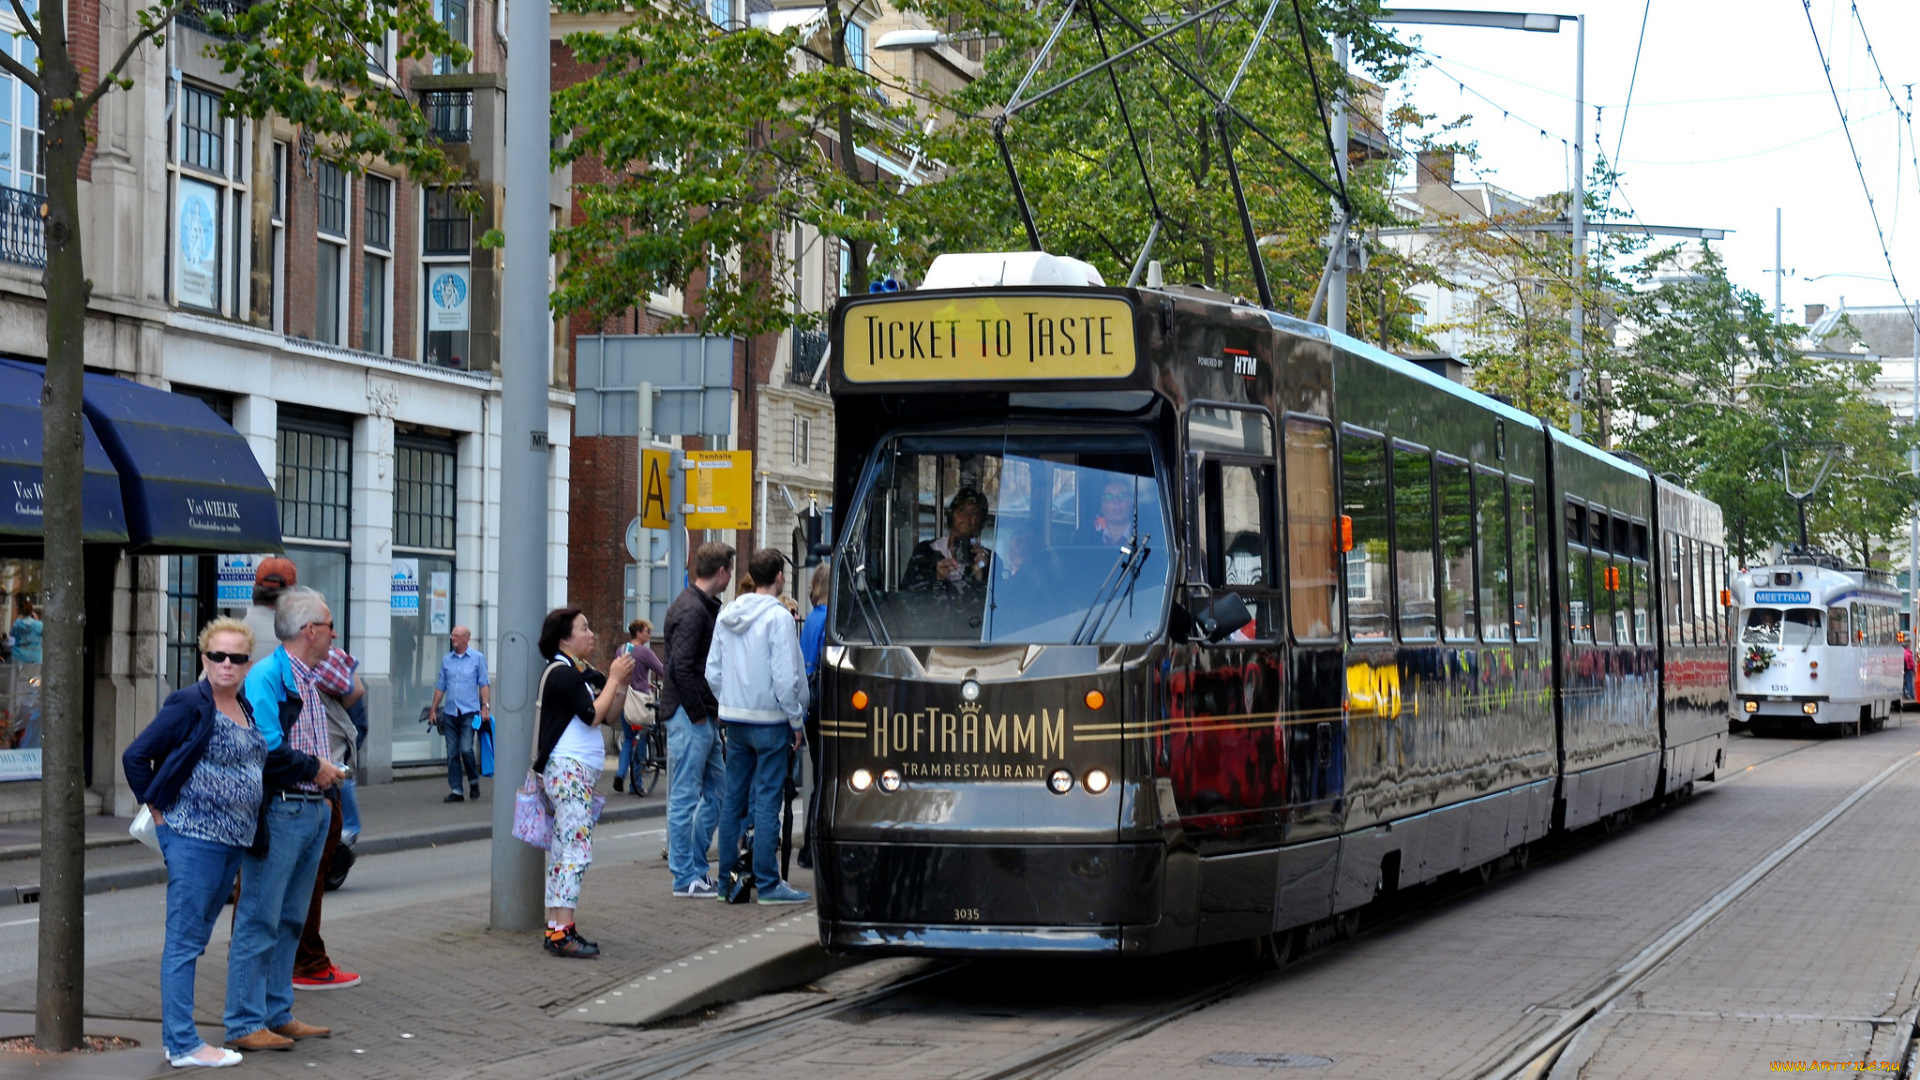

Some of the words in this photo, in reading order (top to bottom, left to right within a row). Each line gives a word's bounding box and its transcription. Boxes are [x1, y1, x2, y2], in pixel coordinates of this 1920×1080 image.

[864, 315, 960, 366] TICKET
[976, 318, 1012, 358] TO
[1023, 311, 1114, 363] TASTE
[1197, 356, 1217, 368] POWERED
[1234, 355, 1257, 376] HTM
[643, 457, 667, 521] A
[203, 499, 241, 519] WIELIK
[1755, 592, 1810, 603] MEETTRAM
[1771, 684, 1789, 693] 1315
[902, 762, 1046, 779] TRAMRESTAURANT
[954, 908, 980, 921] 3035
